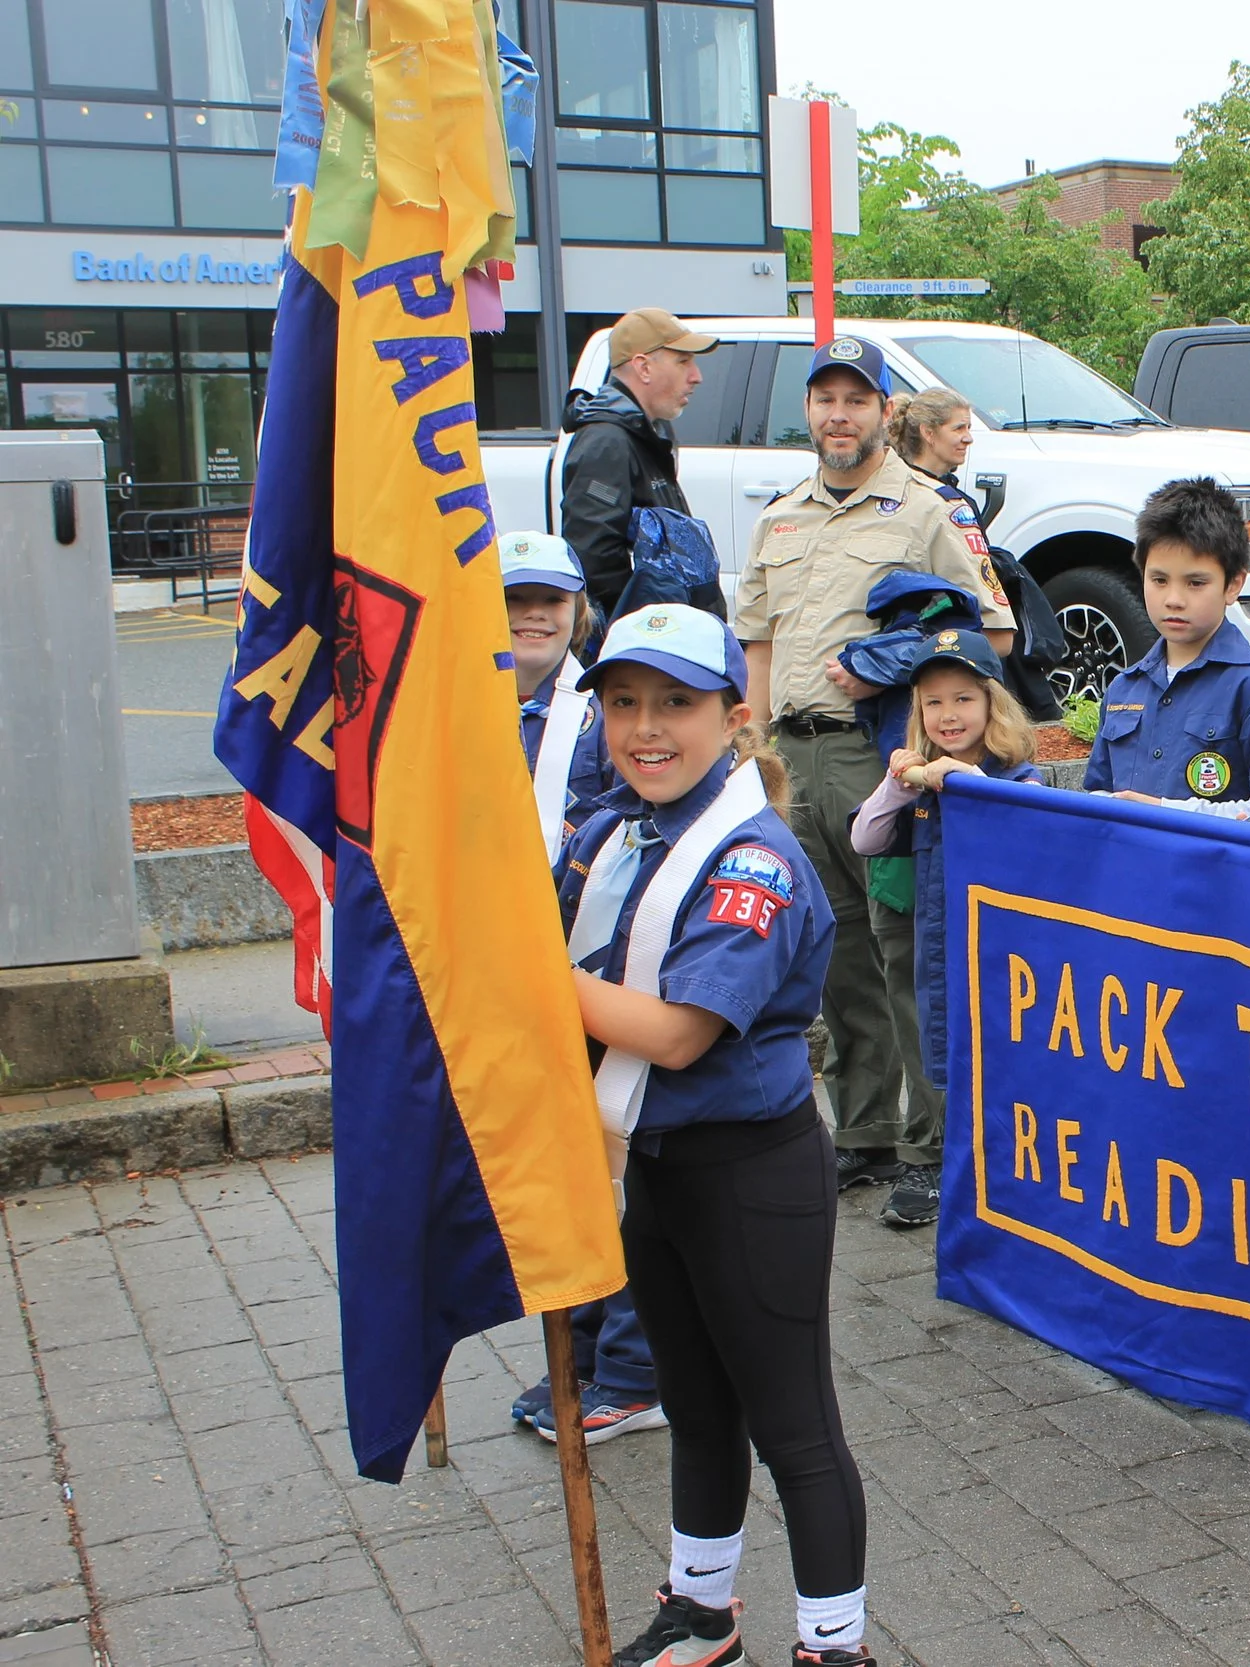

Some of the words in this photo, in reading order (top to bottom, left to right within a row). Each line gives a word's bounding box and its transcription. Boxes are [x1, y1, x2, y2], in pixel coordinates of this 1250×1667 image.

[72, 251, 155, 282] Bank
[159, 253, 190, 283] of
[855, 281, 913, 293] Clearance
[923, 281, 930, 292] 9
[933, 281, 947, 292] ft.
[949, 281, 956, 292] 6
[958, 281, 973, 292] in.
[45, 330, 84, 348] 580
[967, 535, 989, 554] 73
[745, 849, 756, 859] OF
[756, 851, 792, 886] ADVENTURE
[716, 888, 777, 931] 735
[1008, 952, 1185, 1088] PACK
